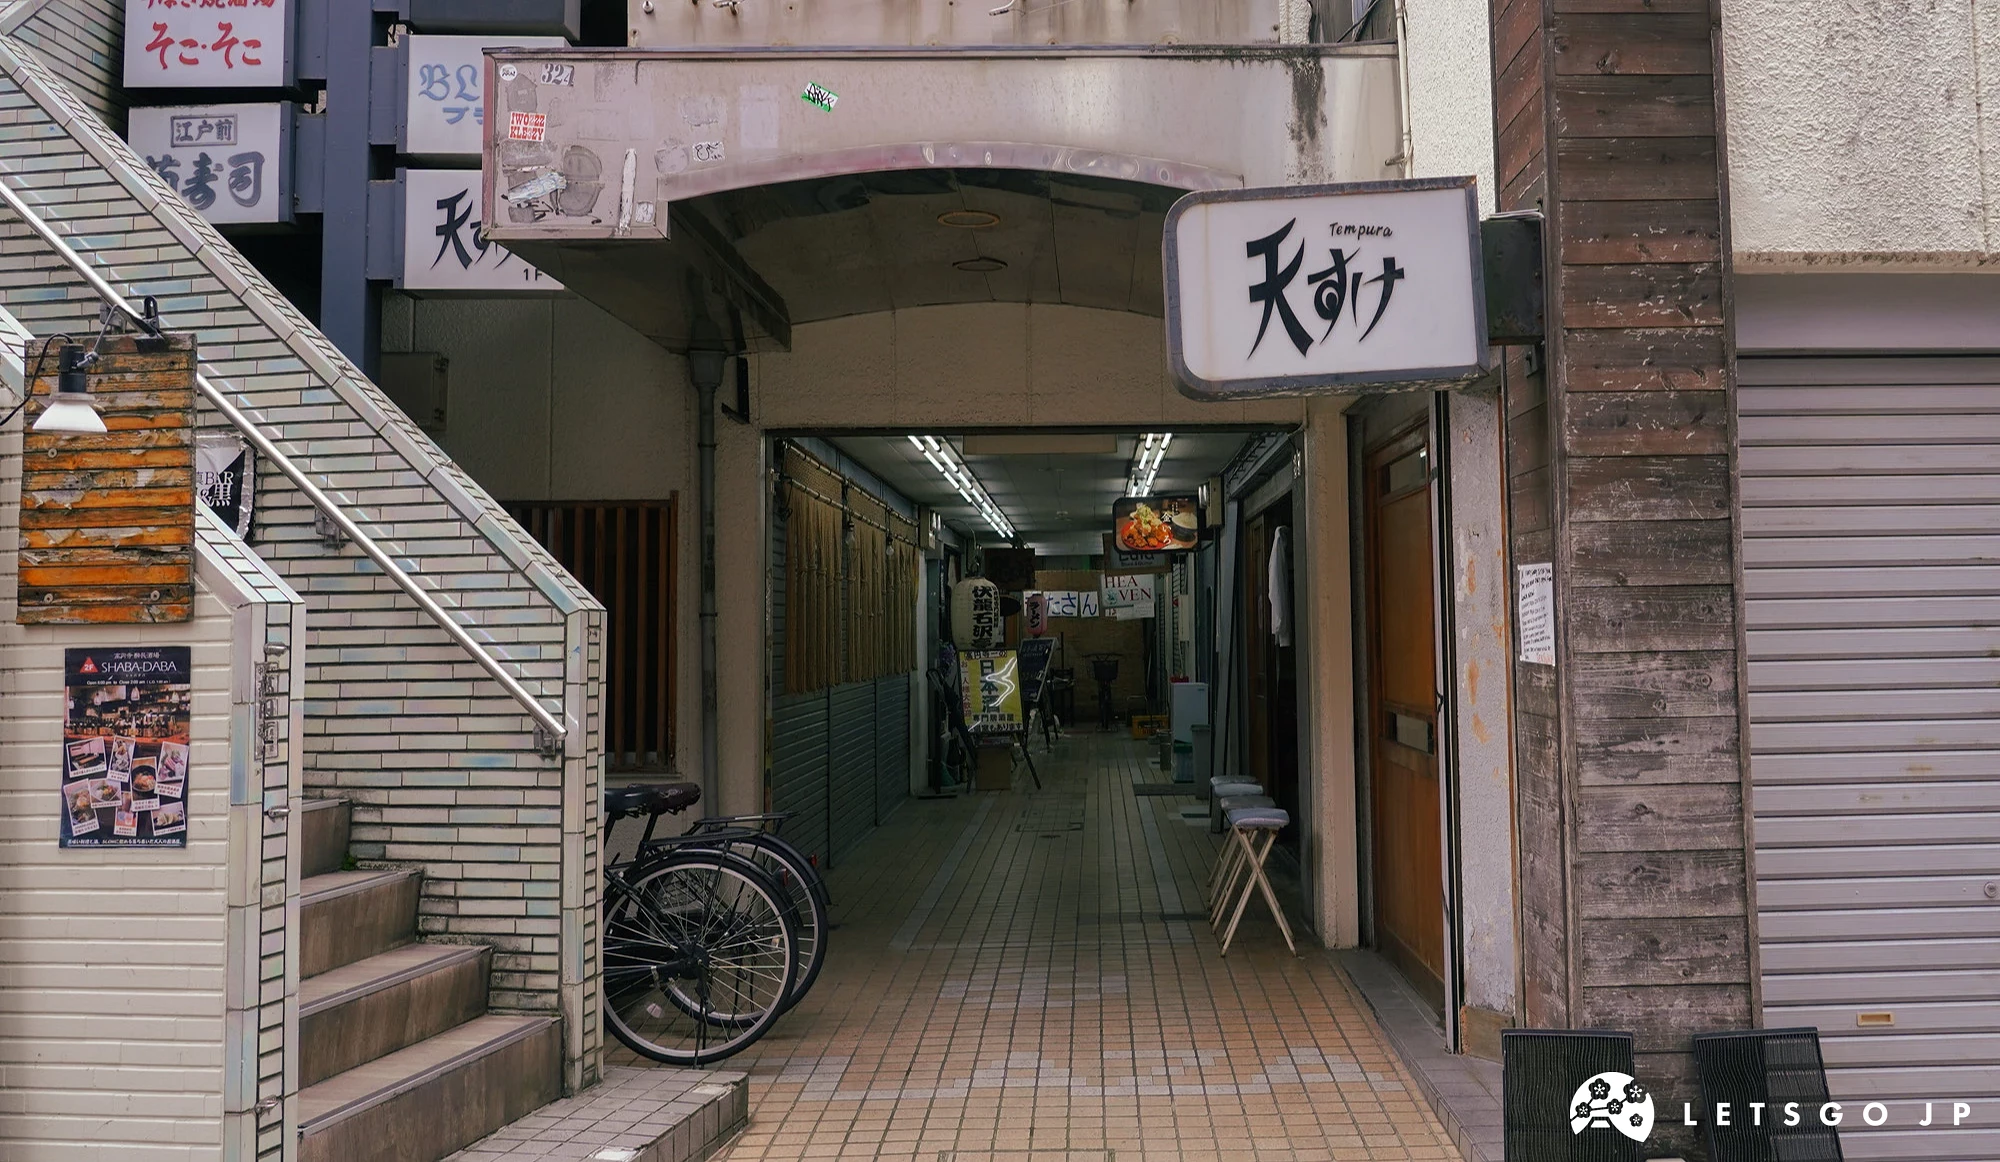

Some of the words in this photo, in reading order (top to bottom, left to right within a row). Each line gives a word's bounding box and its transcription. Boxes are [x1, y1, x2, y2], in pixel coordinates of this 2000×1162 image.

[175, 119, 233, 142] 江戸前
[1329, 222, 1393, 241] Tempura
[1246, 217, 1405, 360] 天すけ
[1025, 592, 1097, 616] たさん
[1119, 588, 1152, 602] VEN
[1029, 601, 1041, 628] ラーメン
[83, 663, 94, 672] 2F
[980, 660, 1001, 713] 日本酒
